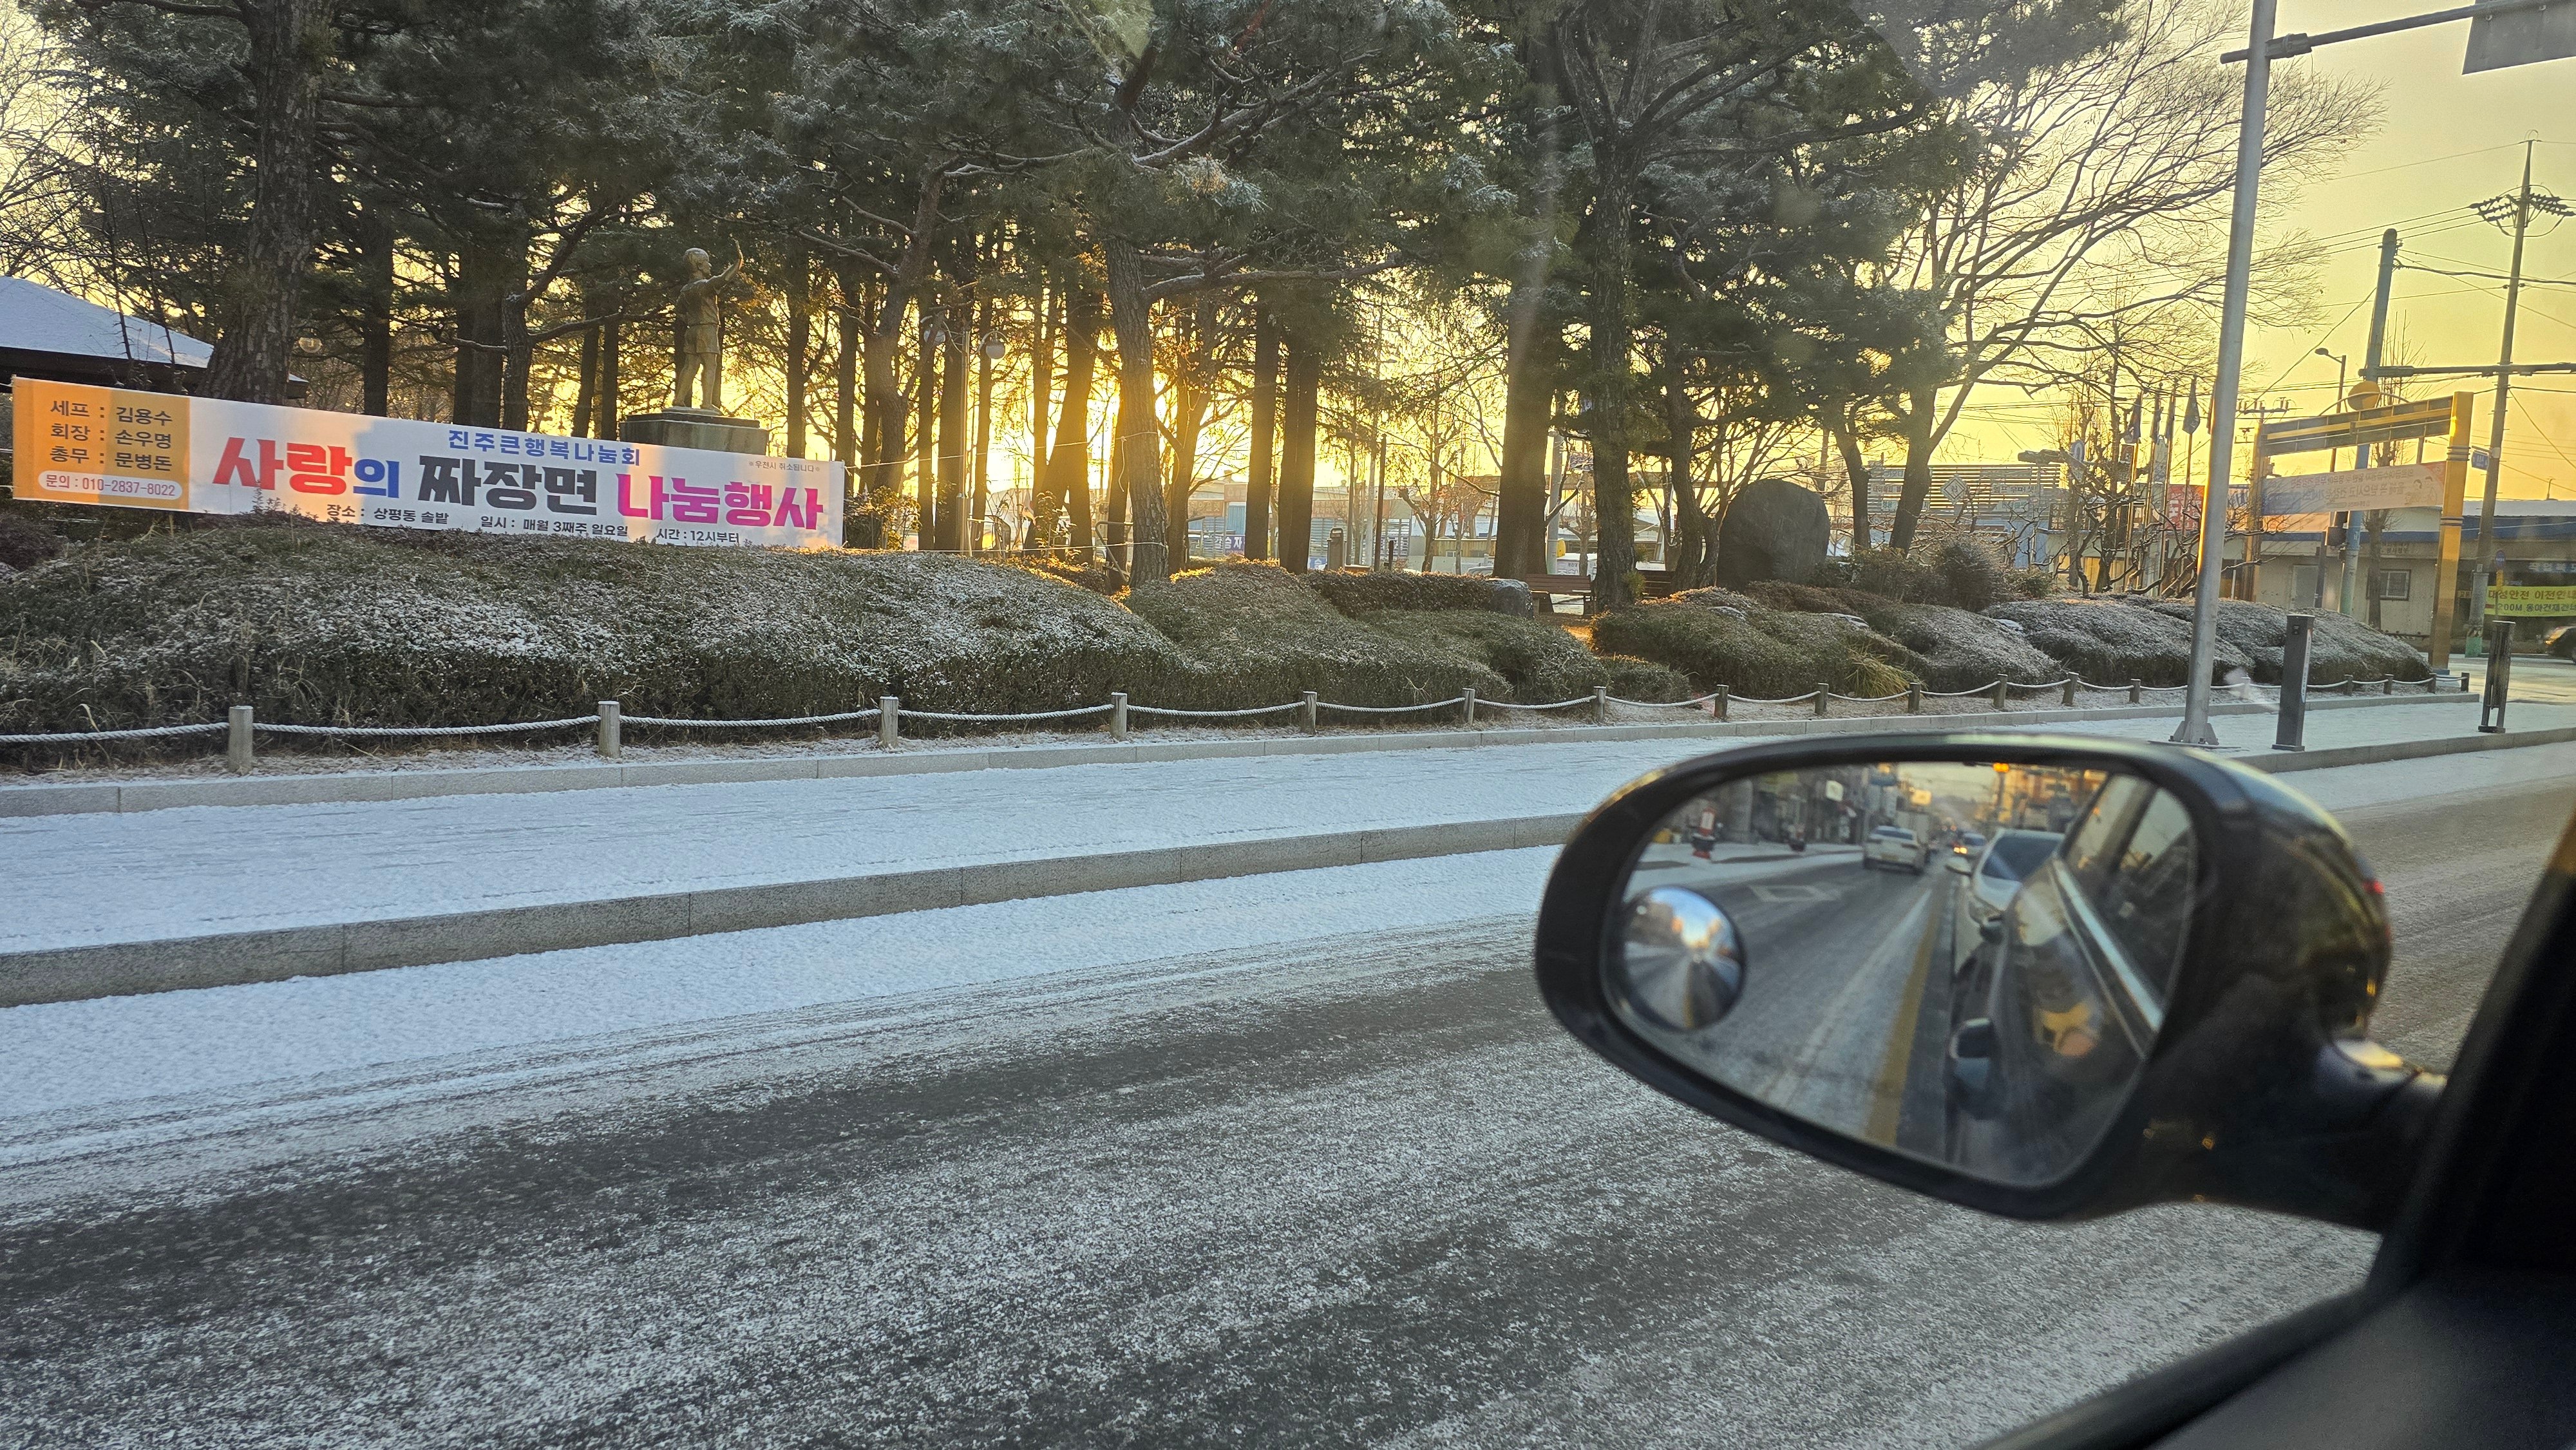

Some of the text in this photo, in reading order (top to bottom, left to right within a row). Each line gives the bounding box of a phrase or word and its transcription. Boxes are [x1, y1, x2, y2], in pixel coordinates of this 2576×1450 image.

[50, 399, 90, 418] 세프
[115, 405, 173, 427] 김용수
[51, 423, 90, 442] 회장
[115, 428, 172, 449] 손우명
[449, 429, 639, 466] 진주큰행복나눔회
[50, 446, 90, 464] 총무
[115, 451, 173, 472] 문병돈
[46, 475, 71, 489] 문의
[81, 477, 175, 497] 010-2837-8022
[212, 437, 824, 530] 사랑의 짜장면 나눔행사
[327, 504, 355, 517] 장소
[374, 508, 417, 522] 상평동
[421, 511, 449, 525] 솔밭
[480, 516, 506, 528] 일시
[523, 519, 549, 531] 매월
[553, 521, 587, 534] 3째주
[591, 524, 629, 537] 일요일
[656, 528, 680, 540] 시간
[690, 530, 740, 544] 12시부터
